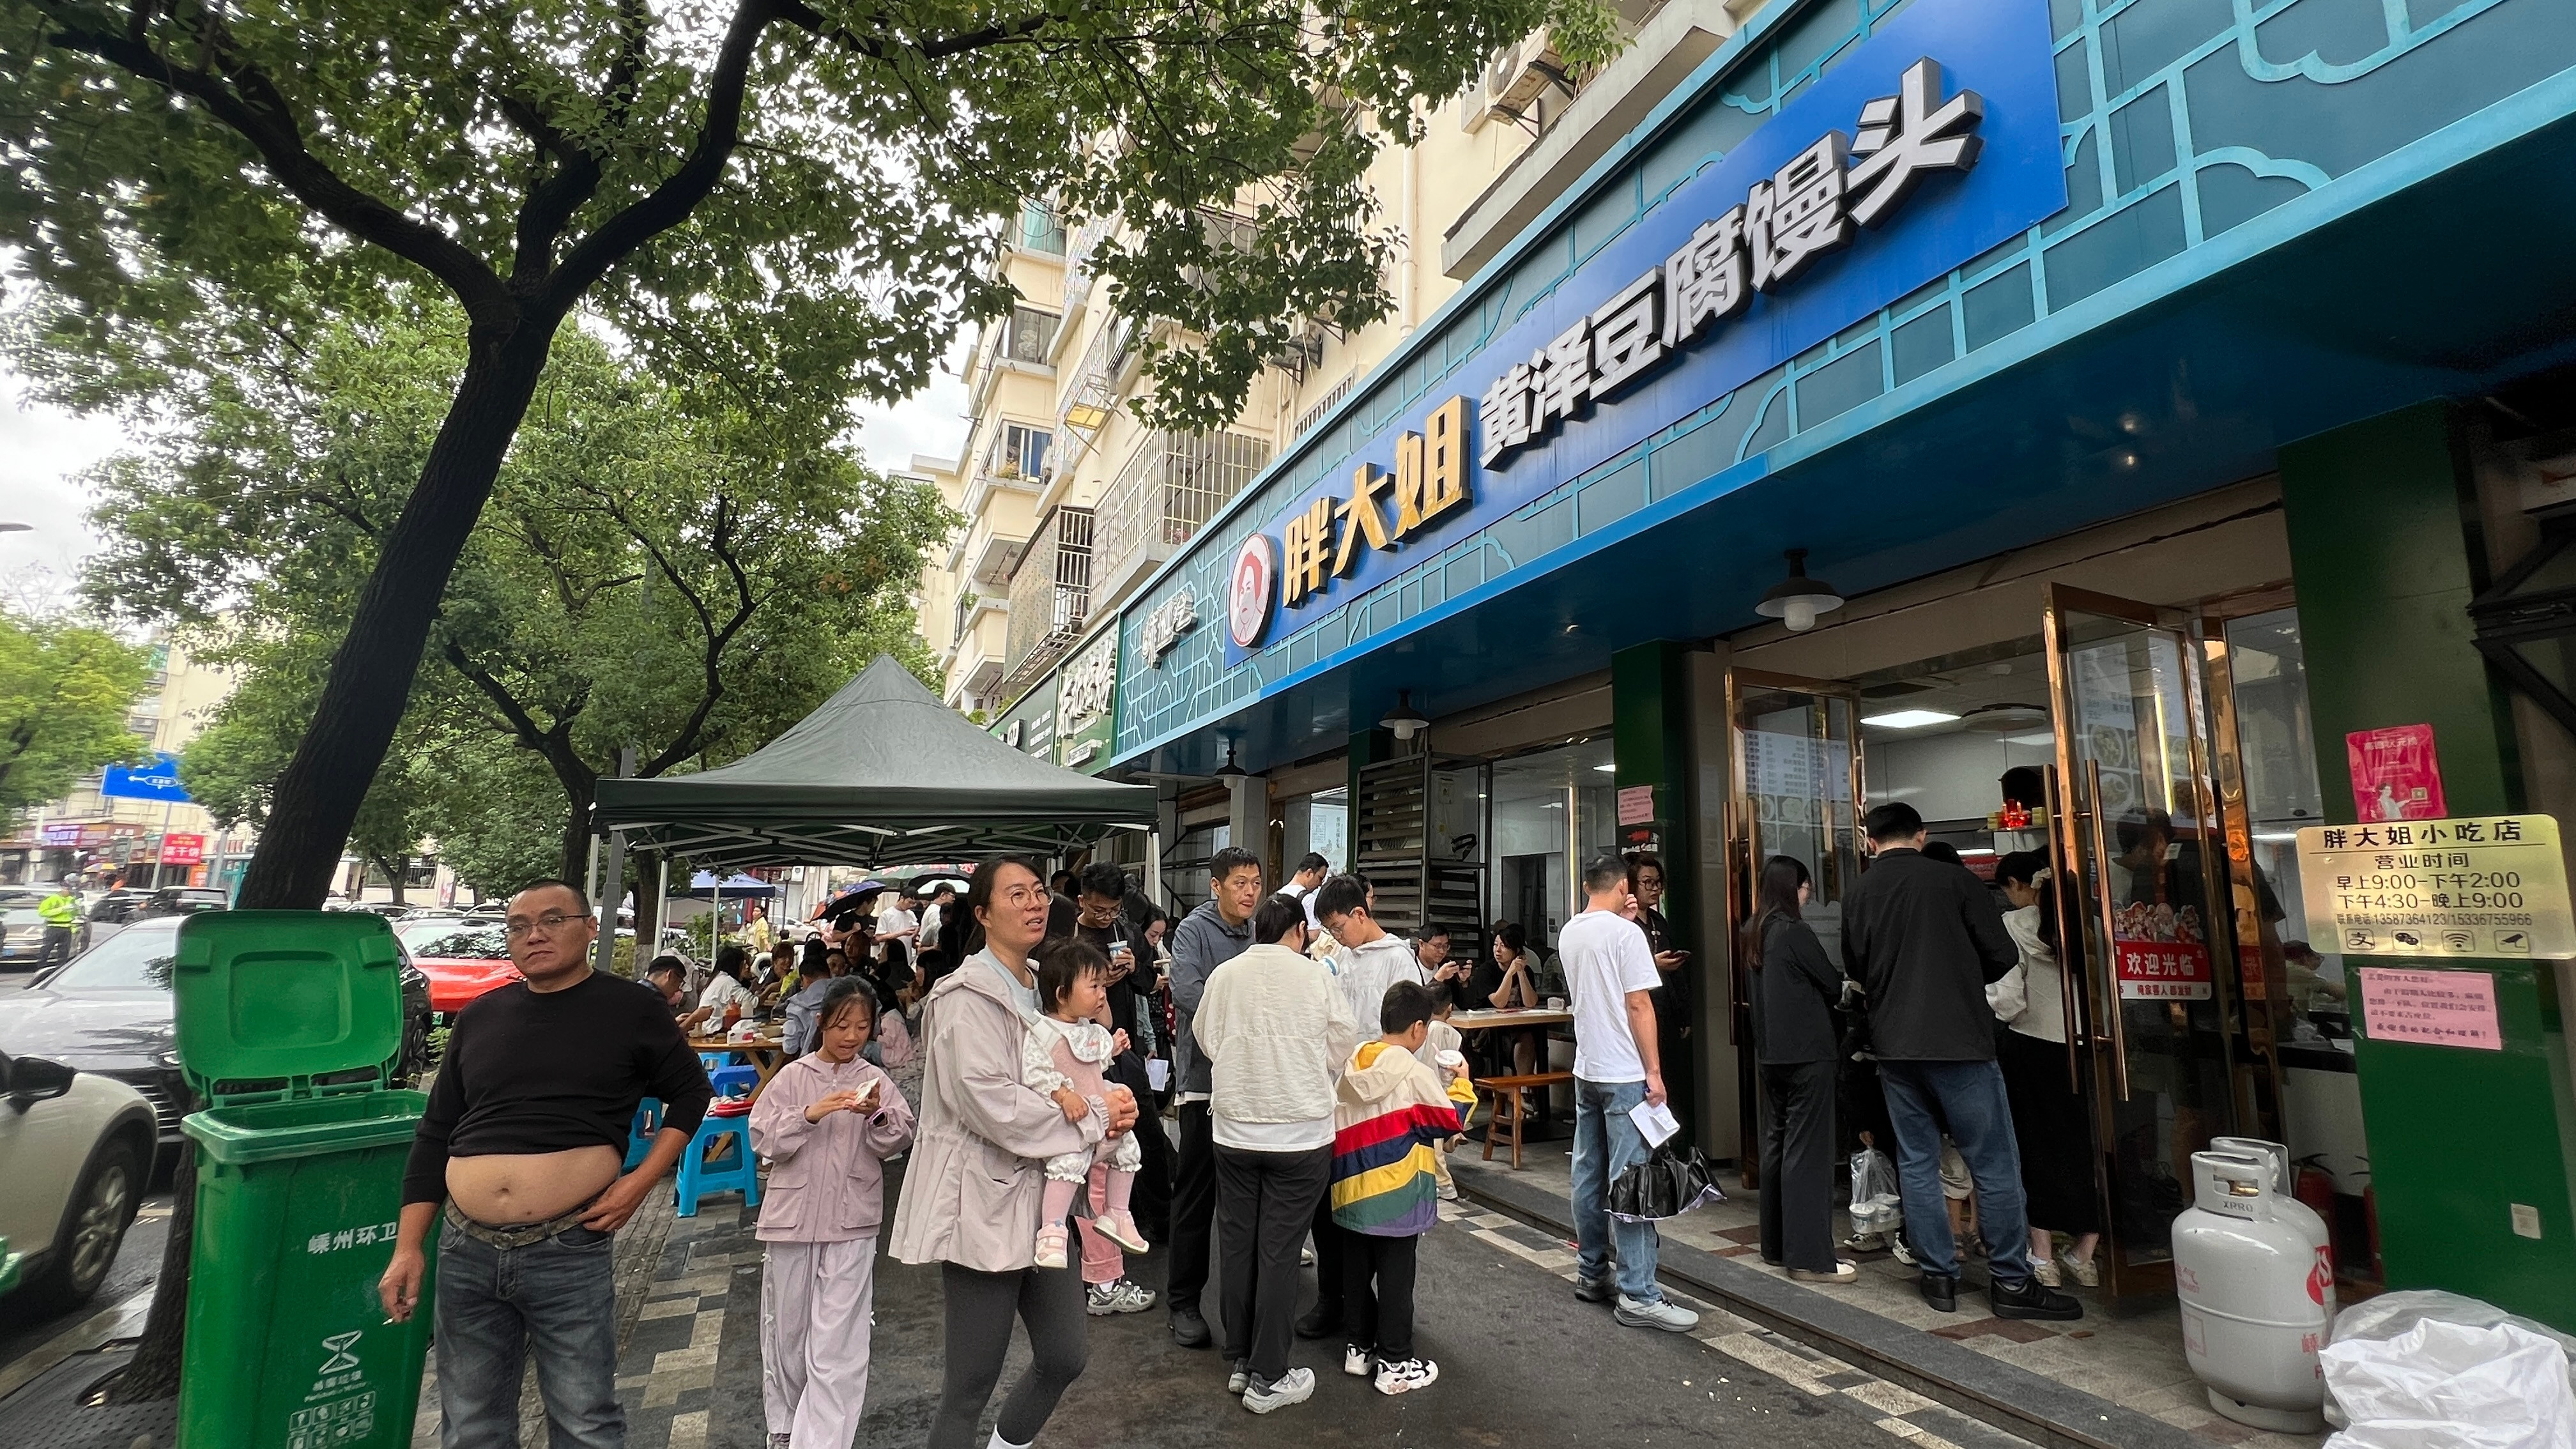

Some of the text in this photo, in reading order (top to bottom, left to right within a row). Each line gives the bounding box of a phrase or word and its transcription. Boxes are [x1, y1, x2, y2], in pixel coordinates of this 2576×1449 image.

[1283, 56, 1983, 608] 胖大姐 黄泽豆腐馒头
[2324, 820, 2522, 849] 胖大姐小吃店
[2374, 852, 2469, 870] 营业时间
[2336, 872, 2520, 891] 早上9:00-下午2:00
[2338, 893, 2523, 909] 下午4:30-晚上9:00
[2126, 951, 2195, 976] 欢迎光临
[307, 1222, 397, 1254] 嵊州环卫
